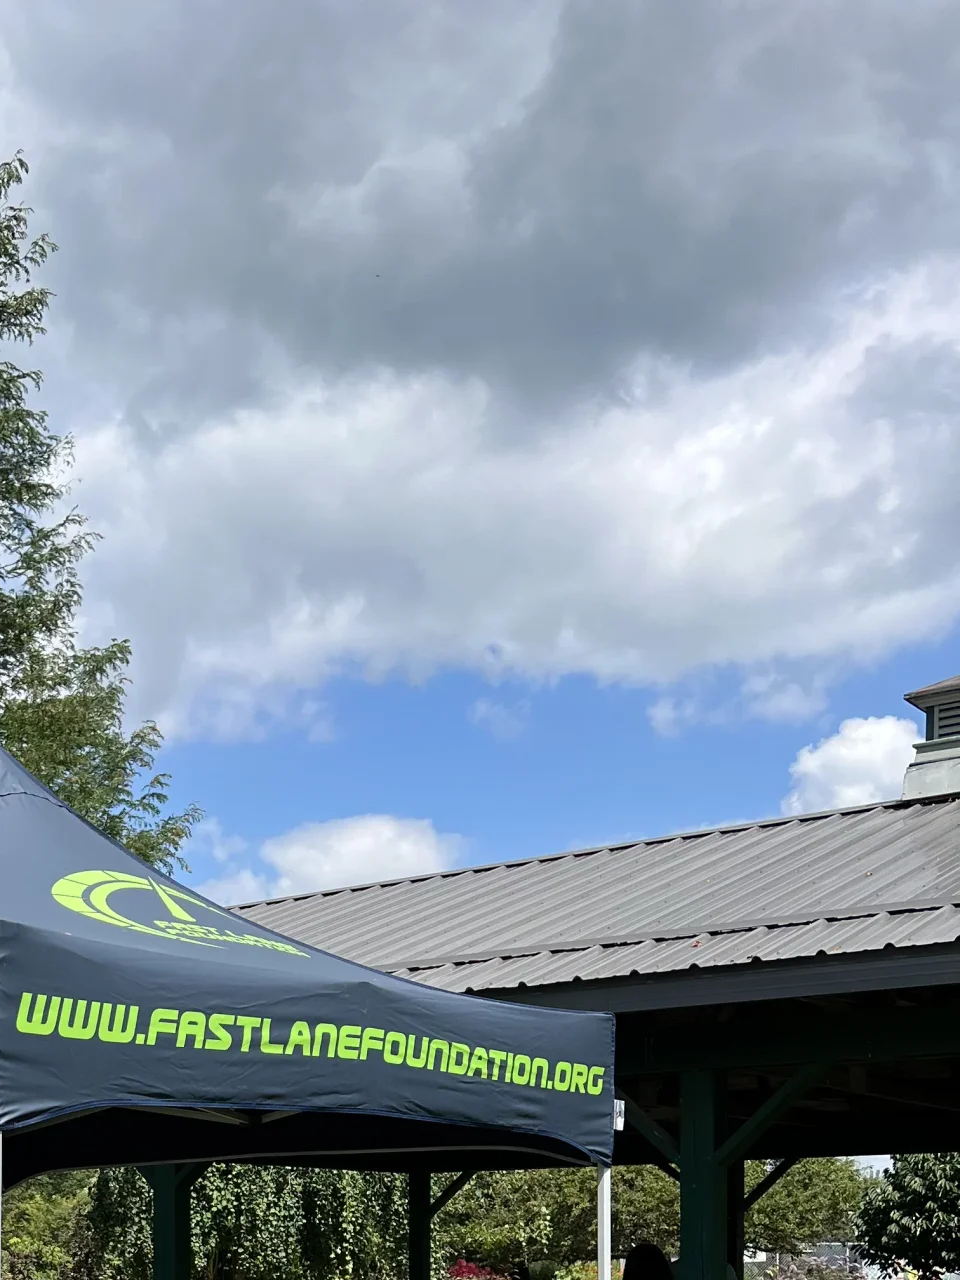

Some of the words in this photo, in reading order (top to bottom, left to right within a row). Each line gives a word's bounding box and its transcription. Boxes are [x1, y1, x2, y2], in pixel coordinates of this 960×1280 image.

[153, 920, 220, 935] FAST
[166, 928, 311, 958] FOUNDATION
[15, 992, 605, 1096] WWW.FASTLANEFOUNDATION.ORG
